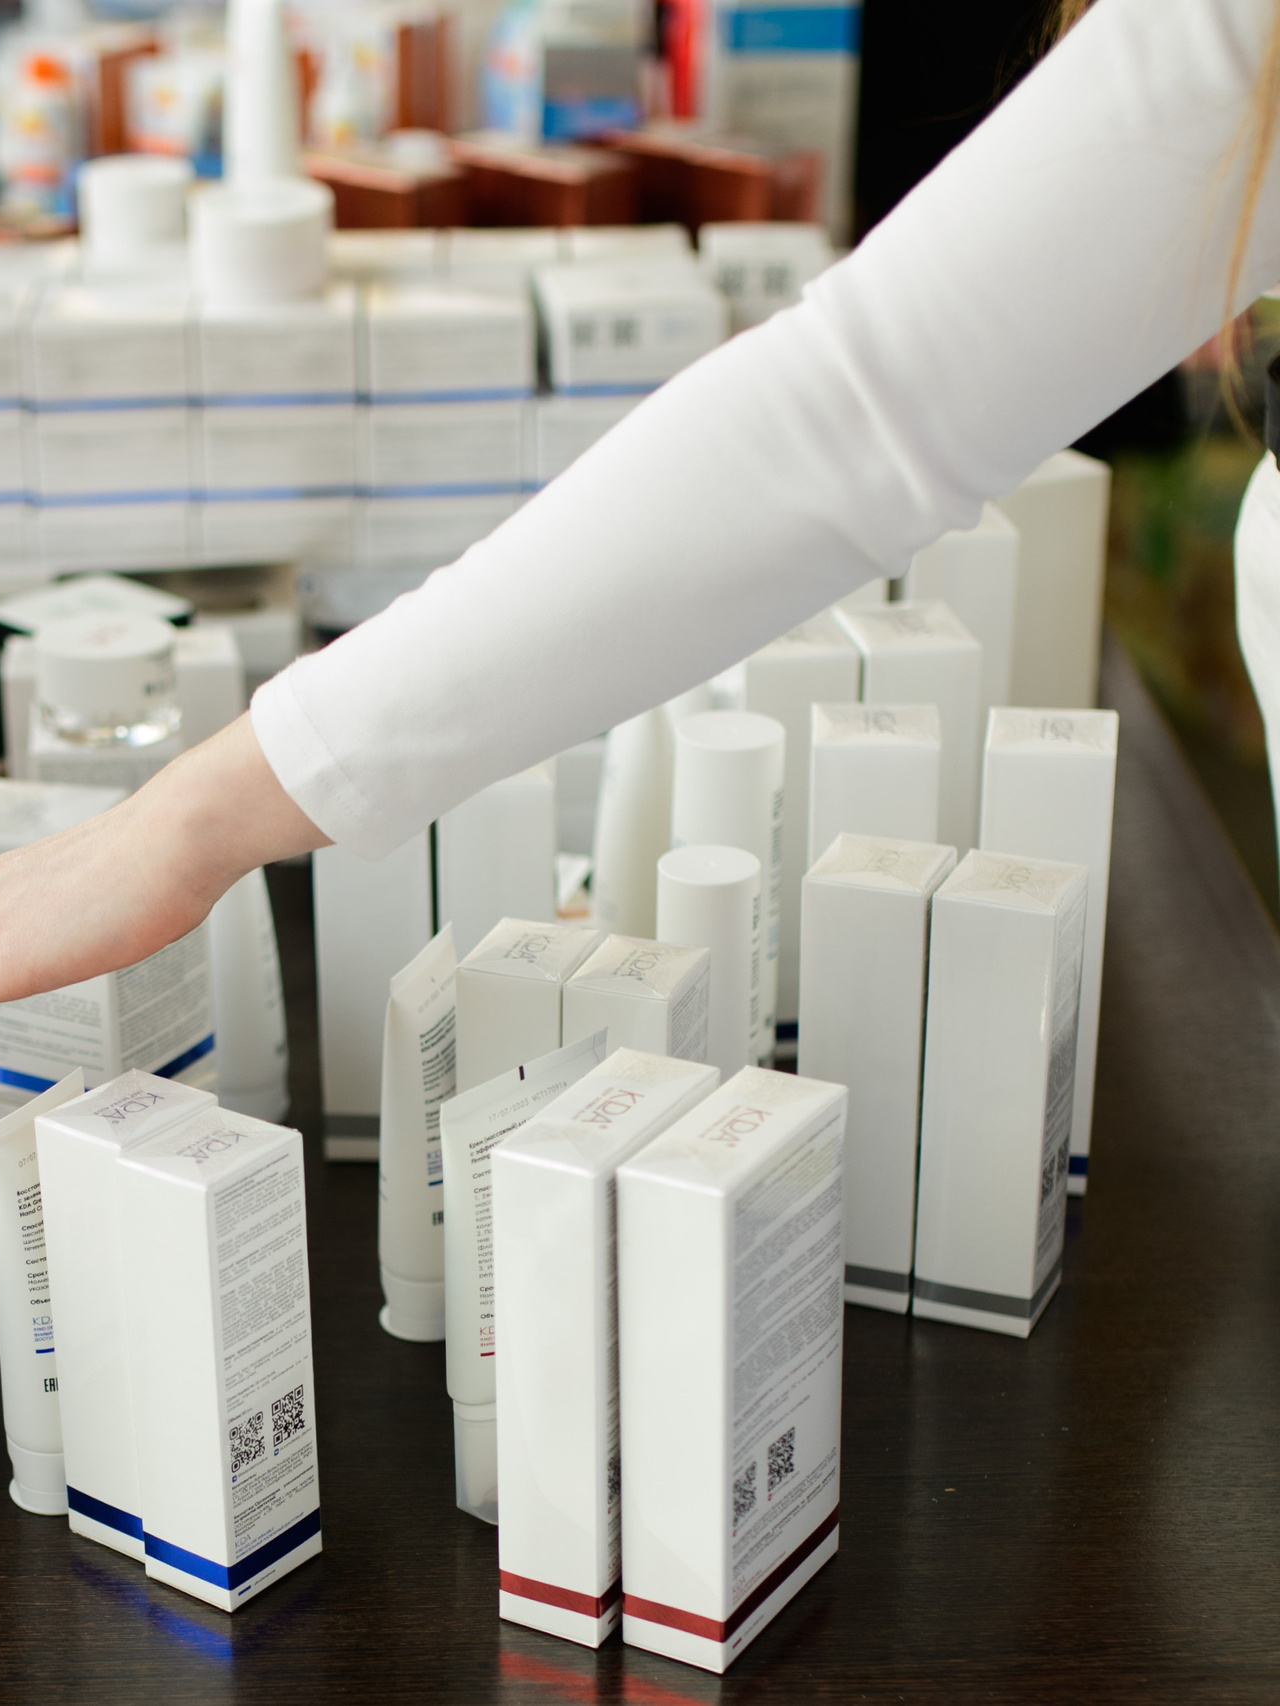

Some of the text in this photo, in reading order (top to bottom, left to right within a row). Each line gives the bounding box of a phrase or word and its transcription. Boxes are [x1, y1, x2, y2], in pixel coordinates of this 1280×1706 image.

[471, 1154, 491, 1164] Firming
[20, 1208, 36, 1217] Hand
[33, 1315, 53, 1326] KD
[234, 1531, 251, 1549] KDA
